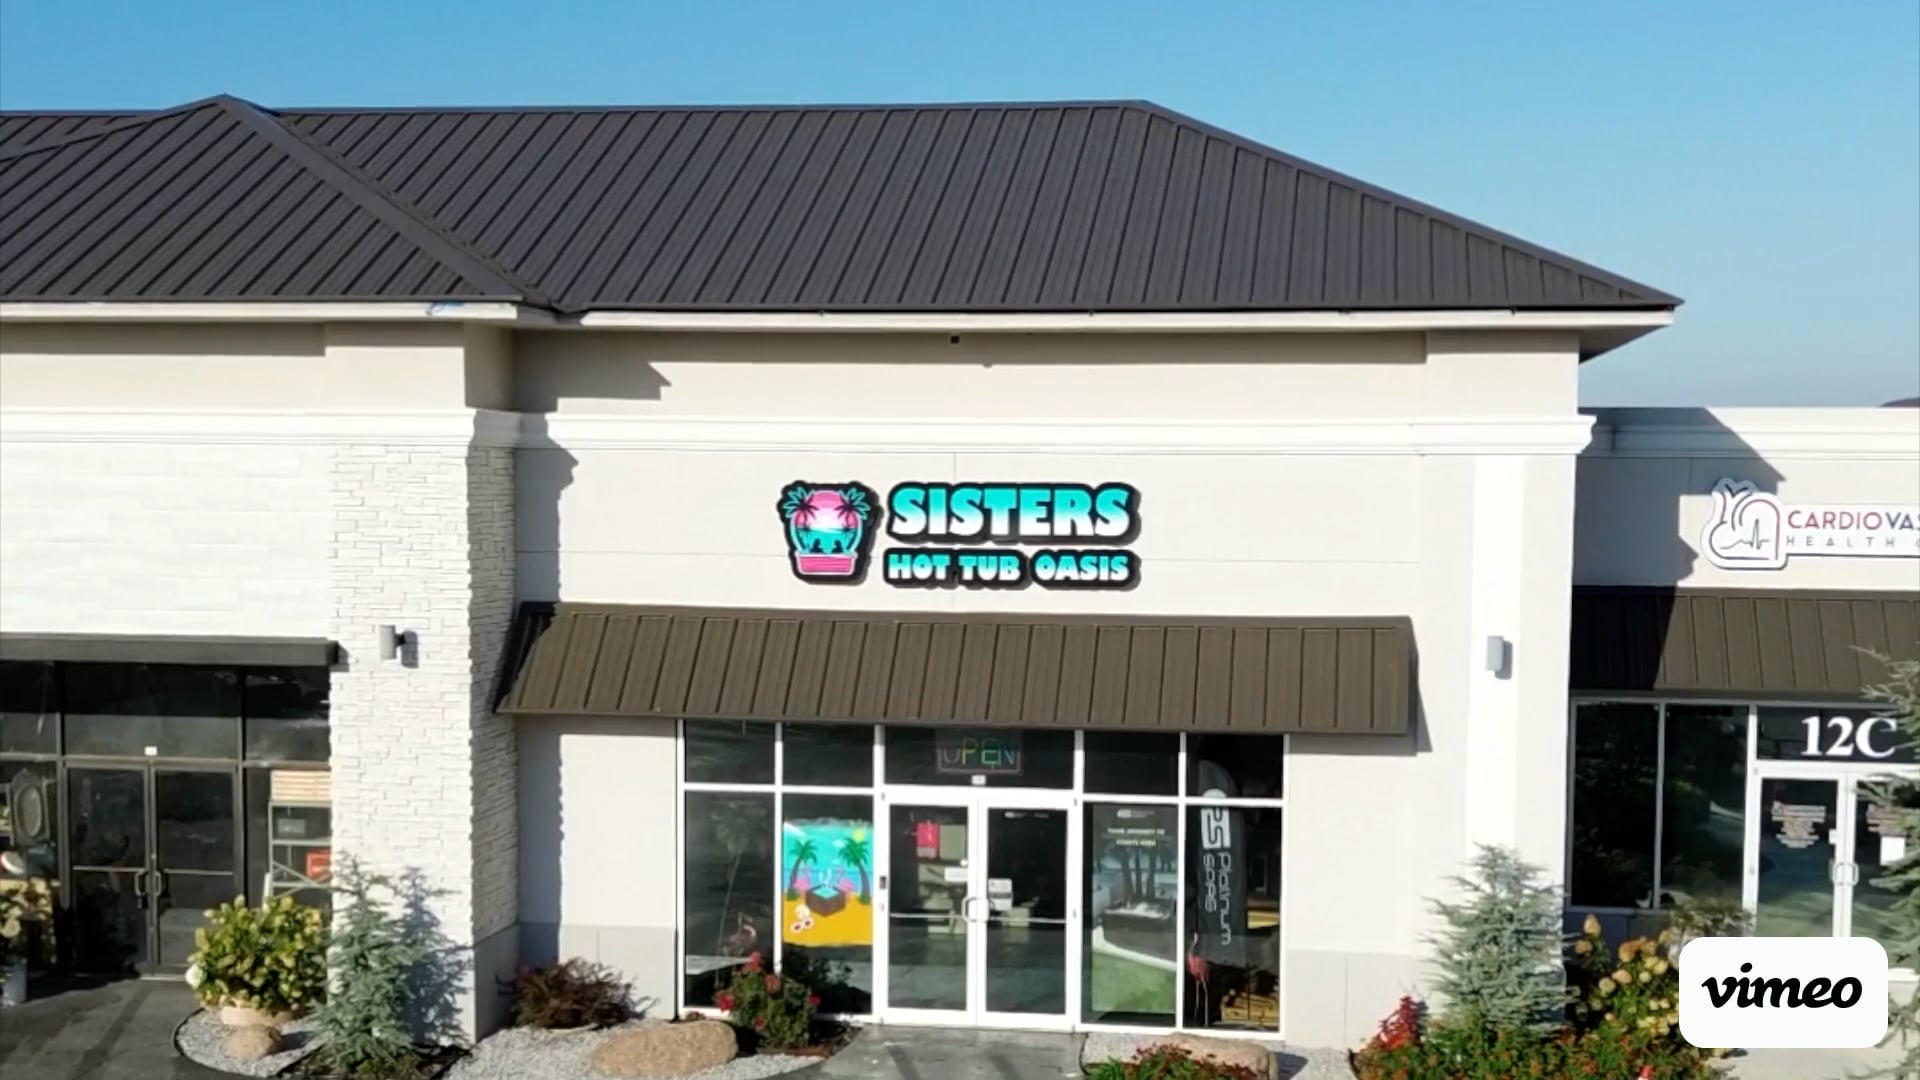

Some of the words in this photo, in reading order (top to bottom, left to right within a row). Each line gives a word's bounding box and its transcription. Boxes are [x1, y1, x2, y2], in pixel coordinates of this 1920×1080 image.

[891, 487, 1130, 537] SISTERS
[1787, 510, 1920, 531] CARDIOVA
[1785, 535, 1896, 549] HEALTH
[888, 553, 951, 581] HOT
[958, 554, 1022, 582] TUB
[1034, 555, 1130, 582] OASIS
[1801, 715, 1898, 759] 12C
